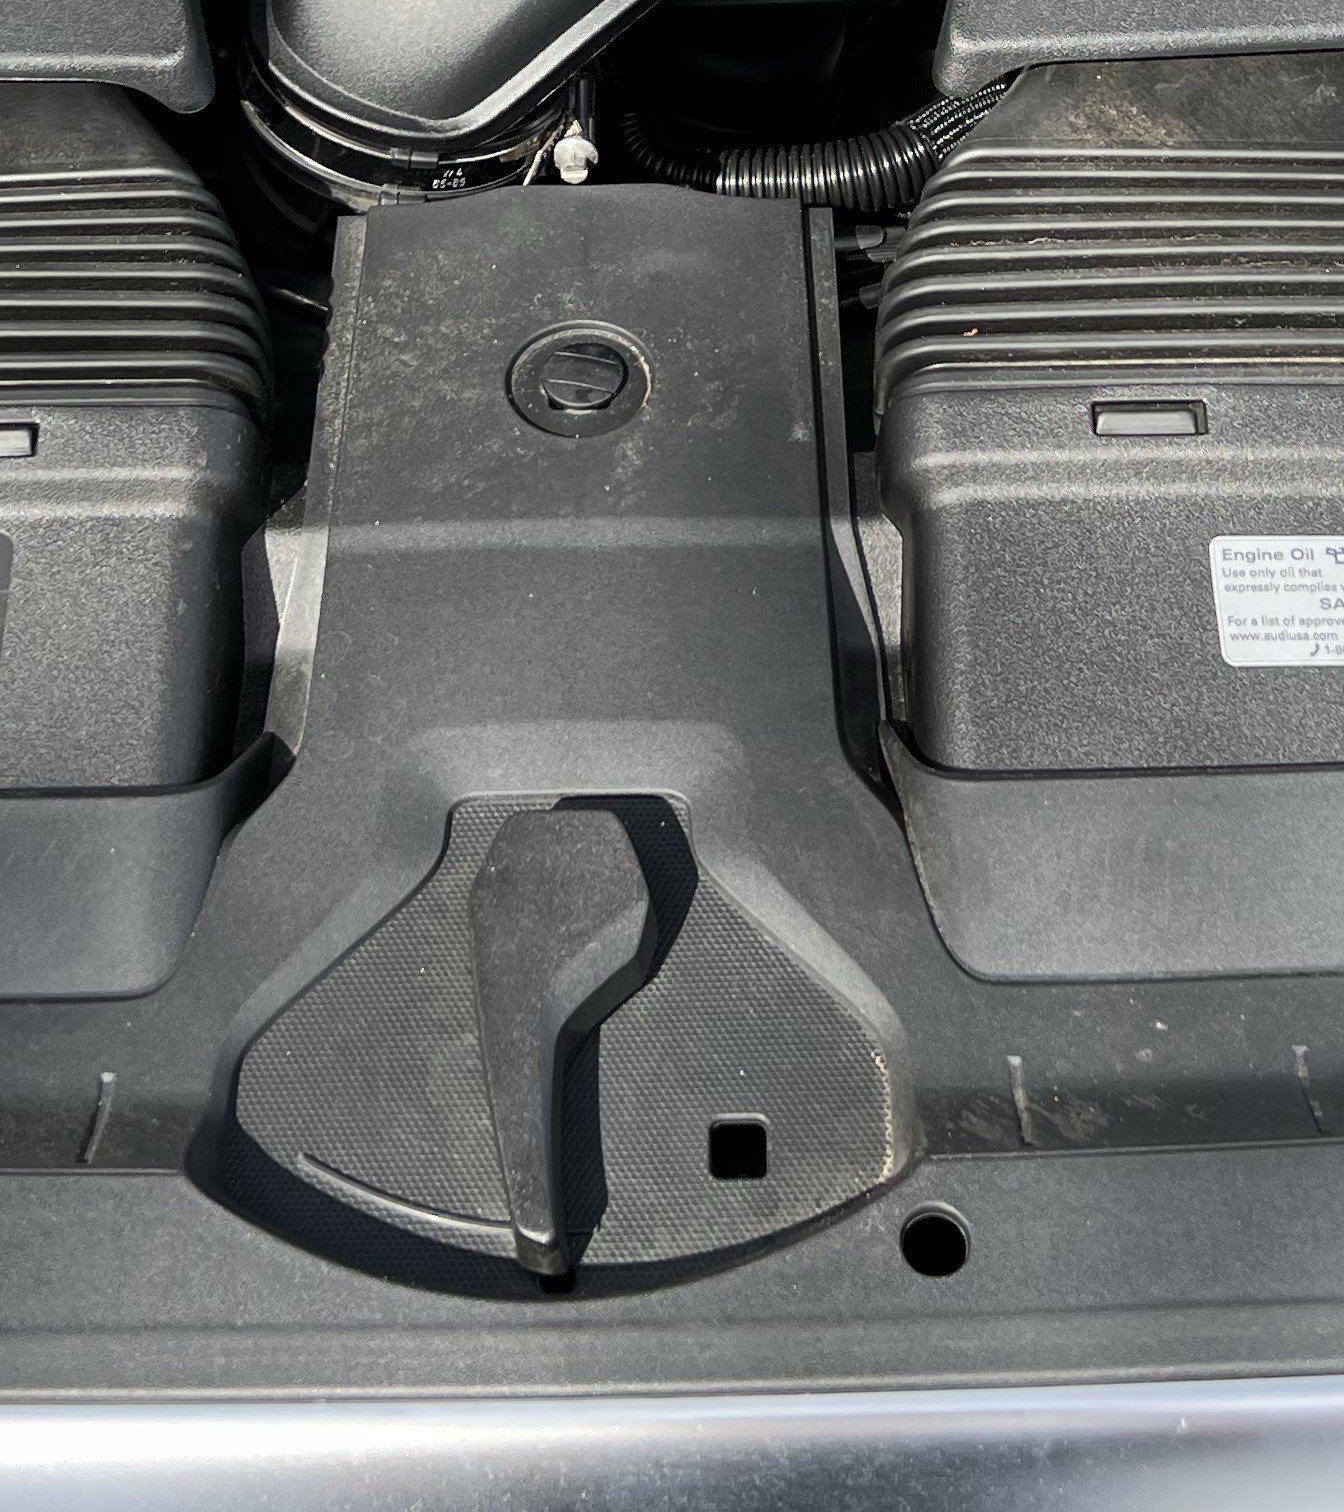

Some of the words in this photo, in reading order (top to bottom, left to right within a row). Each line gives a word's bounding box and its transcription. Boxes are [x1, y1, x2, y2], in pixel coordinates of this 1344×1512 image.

[1222, 548, 1284, 563] Engine
[1290, 548, 1315, 561] Oil
[1222, 567, 1246, 578] Use
[1249, 566, 1276, 579] only
[1280, 565, 1296, 578] oil
[1298, 566, 1323, 577] that
[1224, 582, 1280, 594] expressly
[1283, 581, 1337, 594] complies
[1227, 615, 1247, 626] For
[1251, 617, 1258, 627] a
[1261, 614, 1280, 626] list
[1282, 614, 1296, 626] of
[1229, 630, 1339, 642] www.audiusa.com
